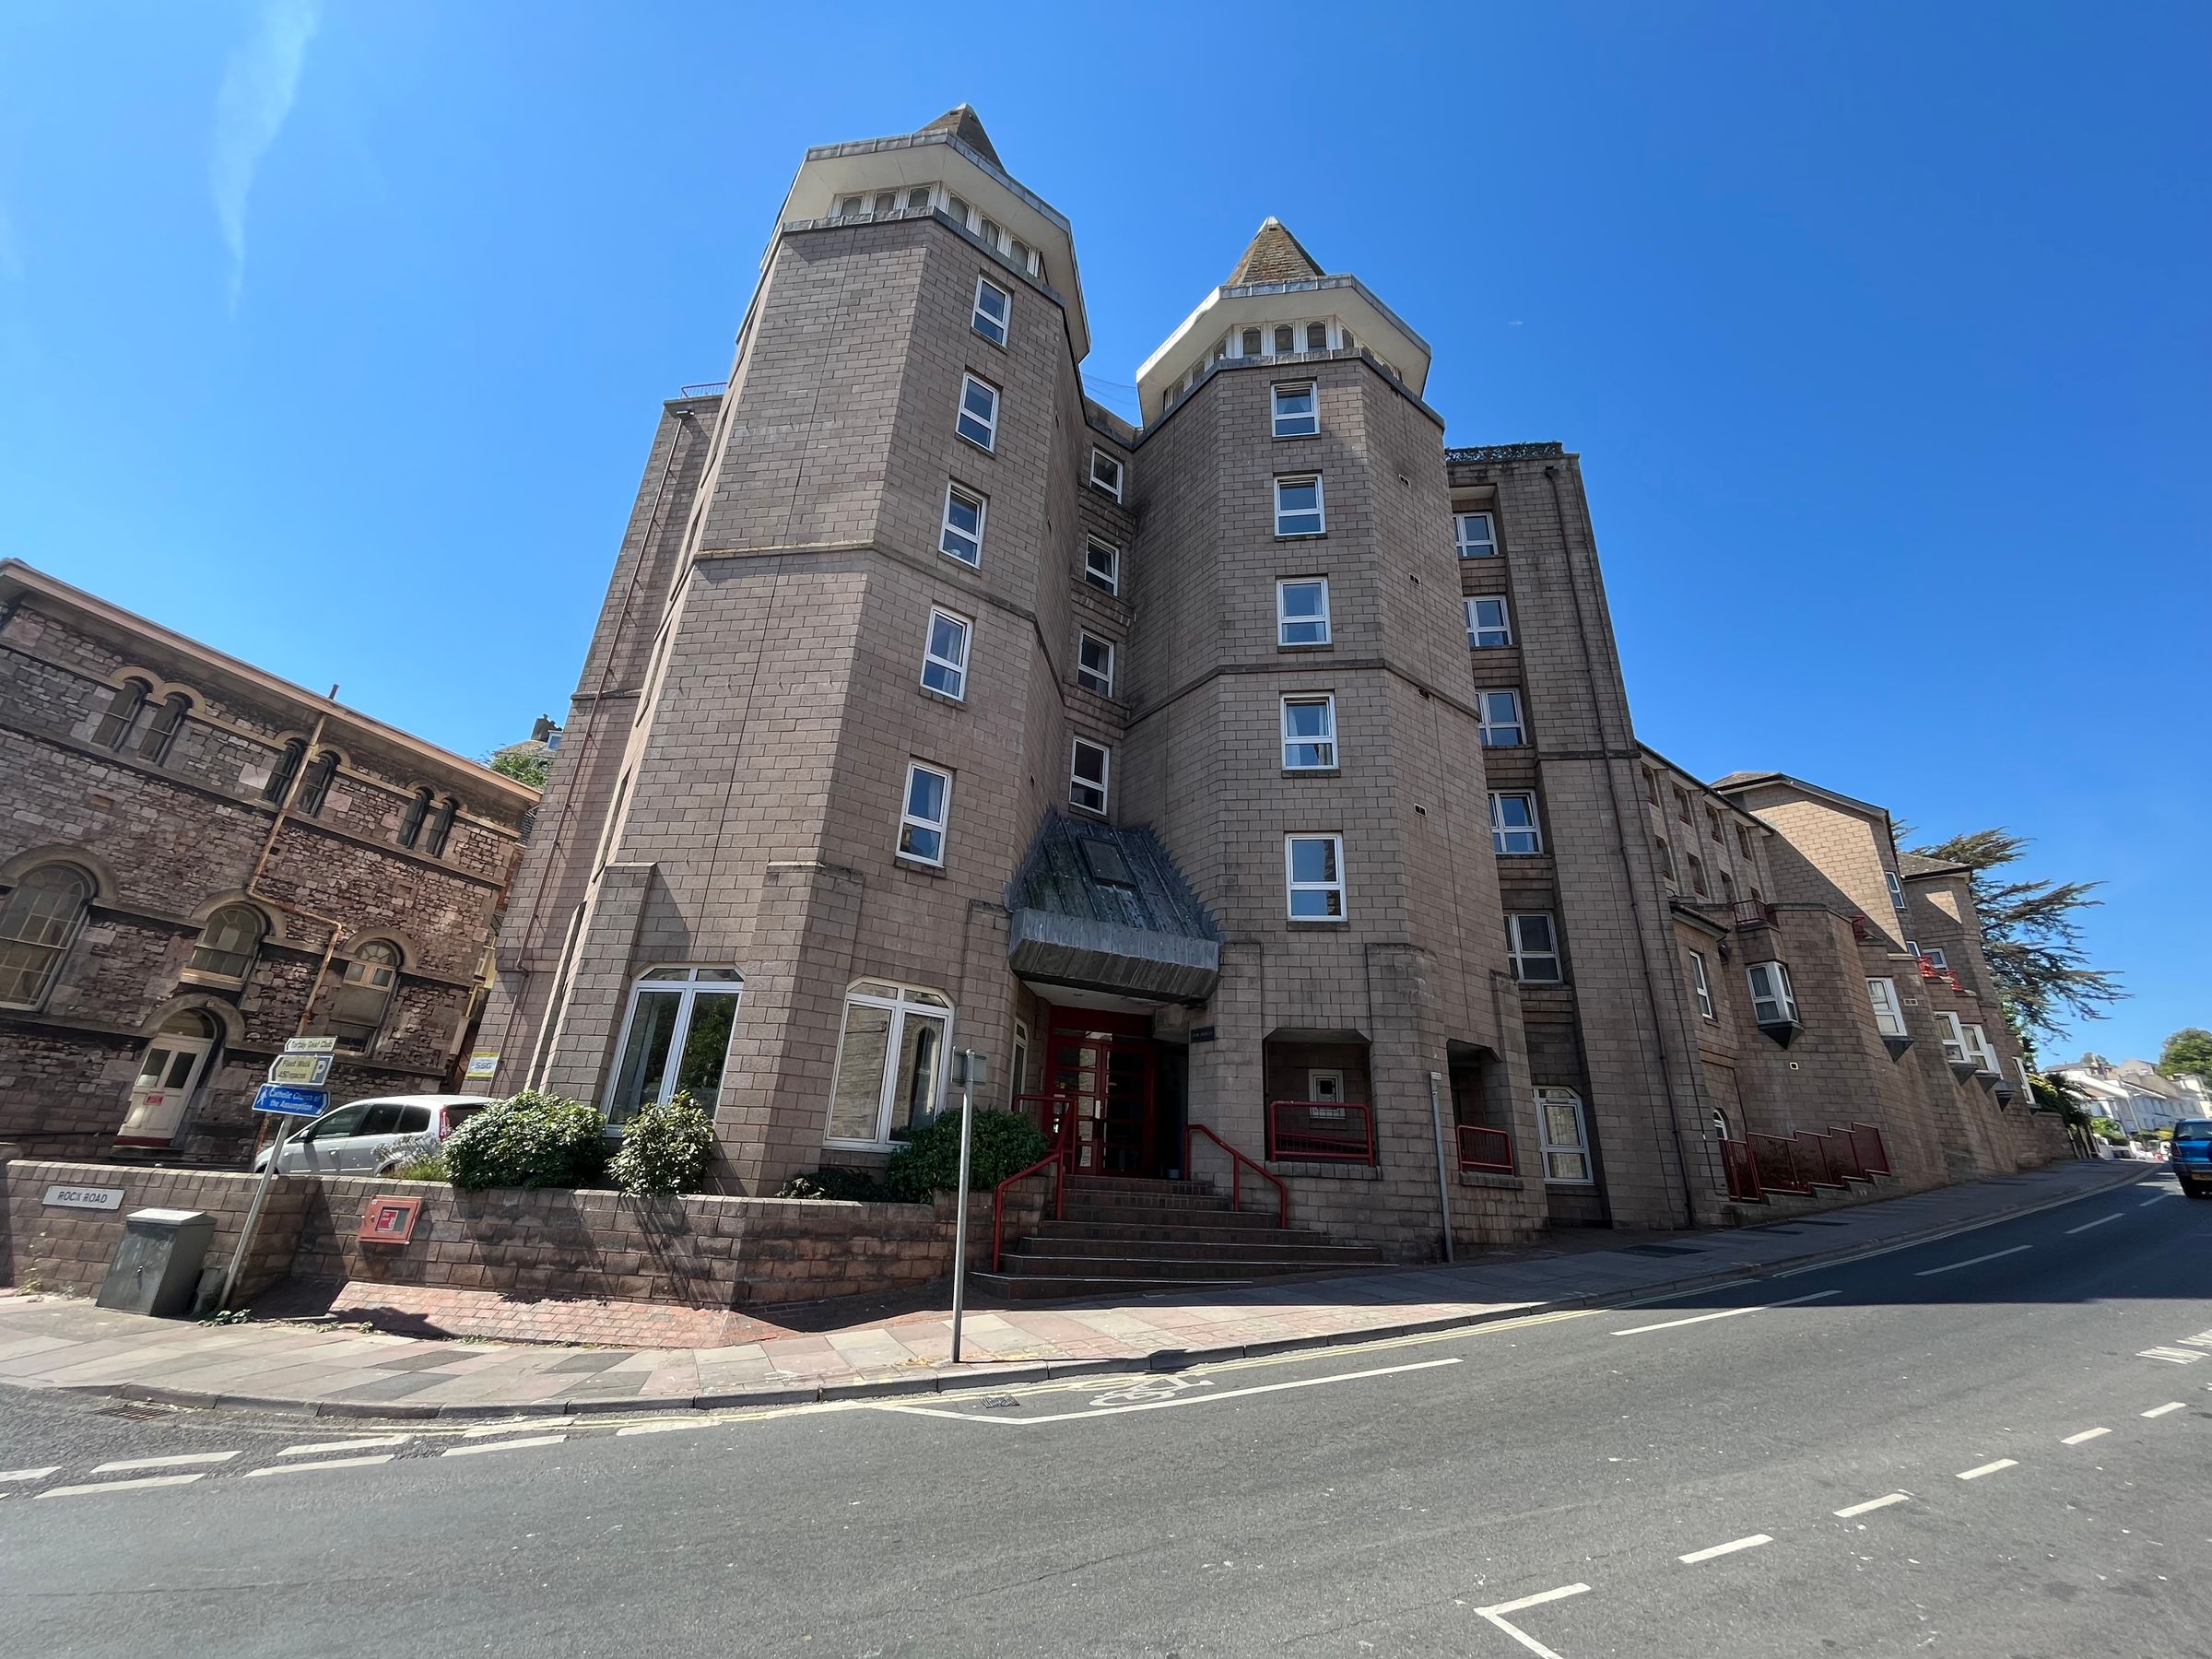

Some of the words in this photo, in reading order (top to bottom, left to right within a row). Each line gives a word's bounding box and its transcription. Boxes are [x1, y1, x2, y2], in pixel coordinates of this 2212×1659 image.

[312, 1060, 326, 1080] P
[475, 1062, 493, 1070] SSG
[269, 1087, 293, 1100] Catholic
[269, 1099, 280, 1107] the
[280, 1100, 312, 1111] Assumption
[57, 1191, 83, 1202] ROCK
[82, 1193, 108, 1204] ROAD
